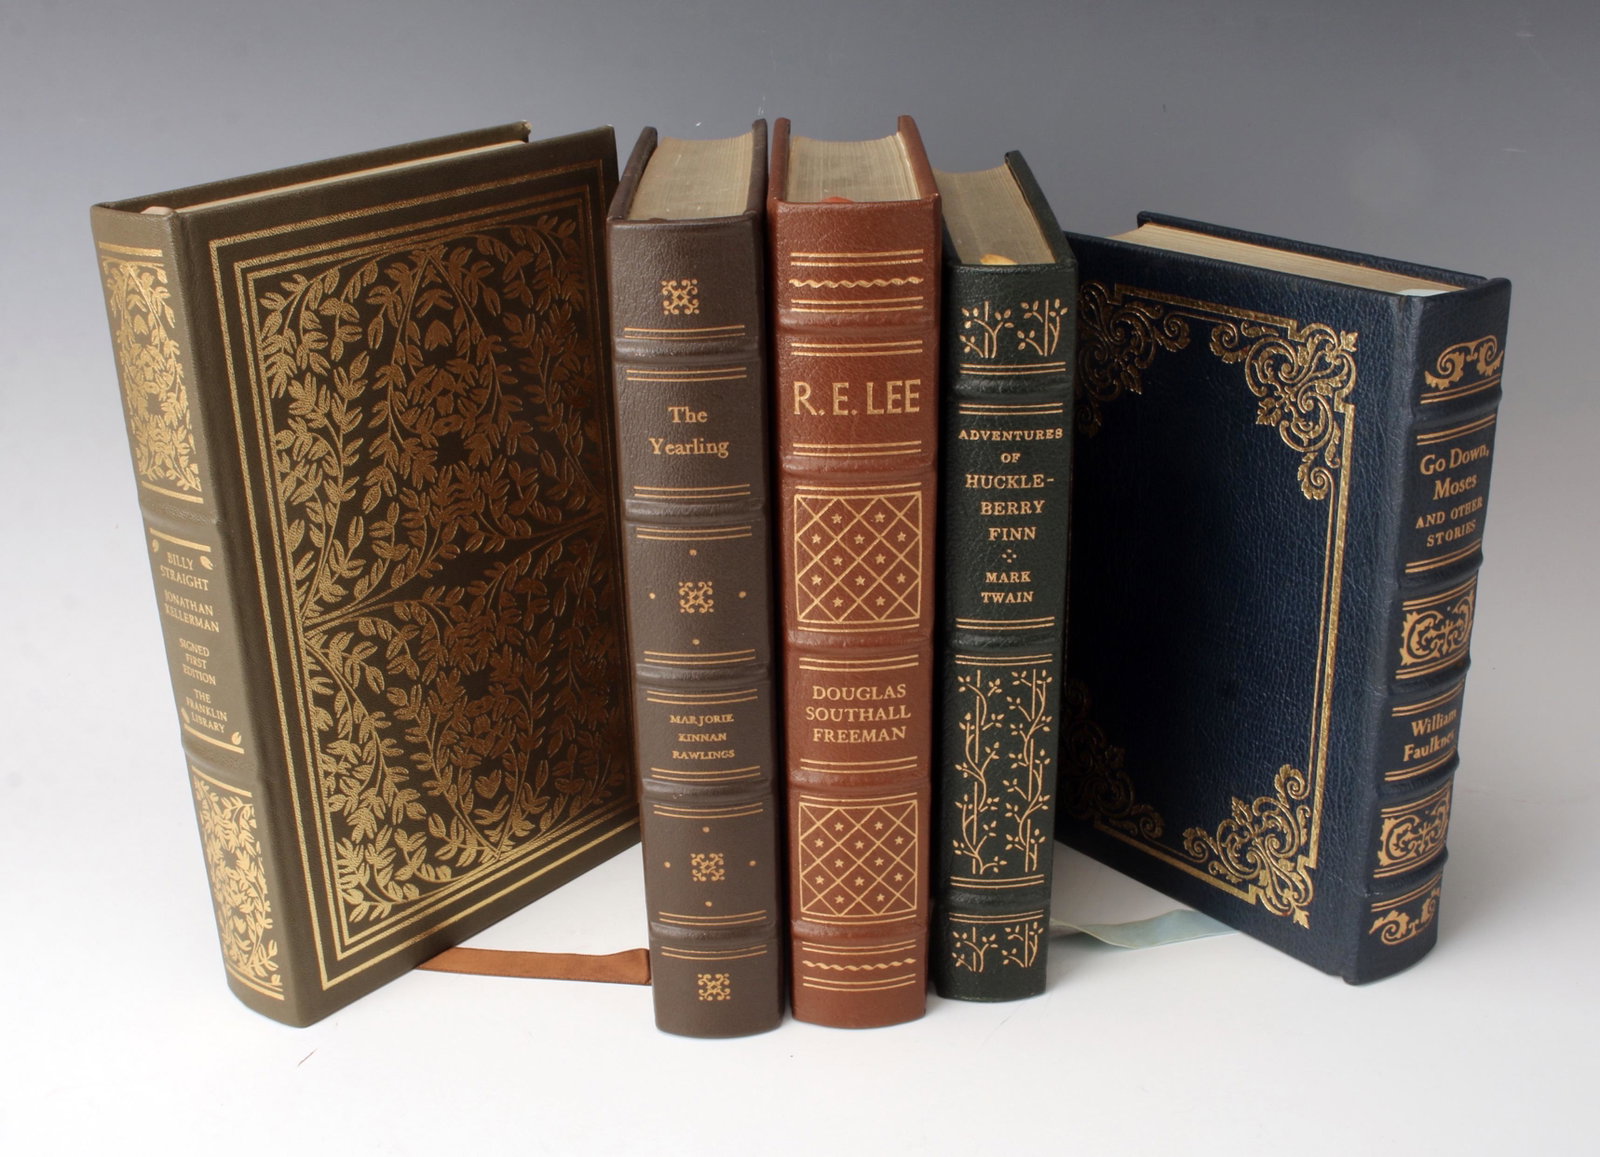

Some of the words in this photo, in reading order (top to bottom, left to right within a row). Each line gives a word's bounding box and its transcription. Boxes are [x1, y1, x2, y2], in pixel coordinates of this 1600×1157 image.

[793, 381, 826, 416] R.
[832, 382, 858, 416] E.
[866, 379, 921, 415] LEE
[667, 405, 708, 424] The
[958, 428, 1064, 441] ADVENTURES
[648, 437, 730, 459] Yearling
[1000, 452, 1021, 463] OF
[1420, 455, 1446, 474] Go
[1450, 445, 1489, 468] Down,
[965, 473, 1055, 489] HUCKLE-
[1434, 475, 1477, 499] Moses
[980, 500, 1045, 515] BERRY
[1416, 512, 1446, 528] AND
[1451, 497, 1482, 519] OTHER
[988, 526, 1037, 541] FINN
[1427, 520, 1476, 546] STORIES
[167, 552, 193, 570] BILLY
[161, 566, 208, 591] STRAIGHT
[985, 571, 1031, 583] MARK
[165, 589, 213, 616] JONATHAN
[980, 591, 1034, 603] TWAIN
[165, 604, 219, 632] KELLERMAN
[179, 639, 209, 656] SIGNED
[186, 654, 207, 669] FIRST
[183, 665, 216, 685] EDITION
[194, 689, 211, 703] THE
[812, 683, 907, 701] DOUGLAS
[187, 697, 227, 721] FRANKLIN
[805, 705, 912, 722] SOUTHALL
[192, 713, 224, 732] LIBRARY
[669, 713, 735, 727] MARJORIE
[1412, 710, 1457, 736] William
[678, 732, 727, 743] KINNAN
[812, 725, 907, 743] FREEMAN
[671, 749, 736, 760] RAWLINGS
